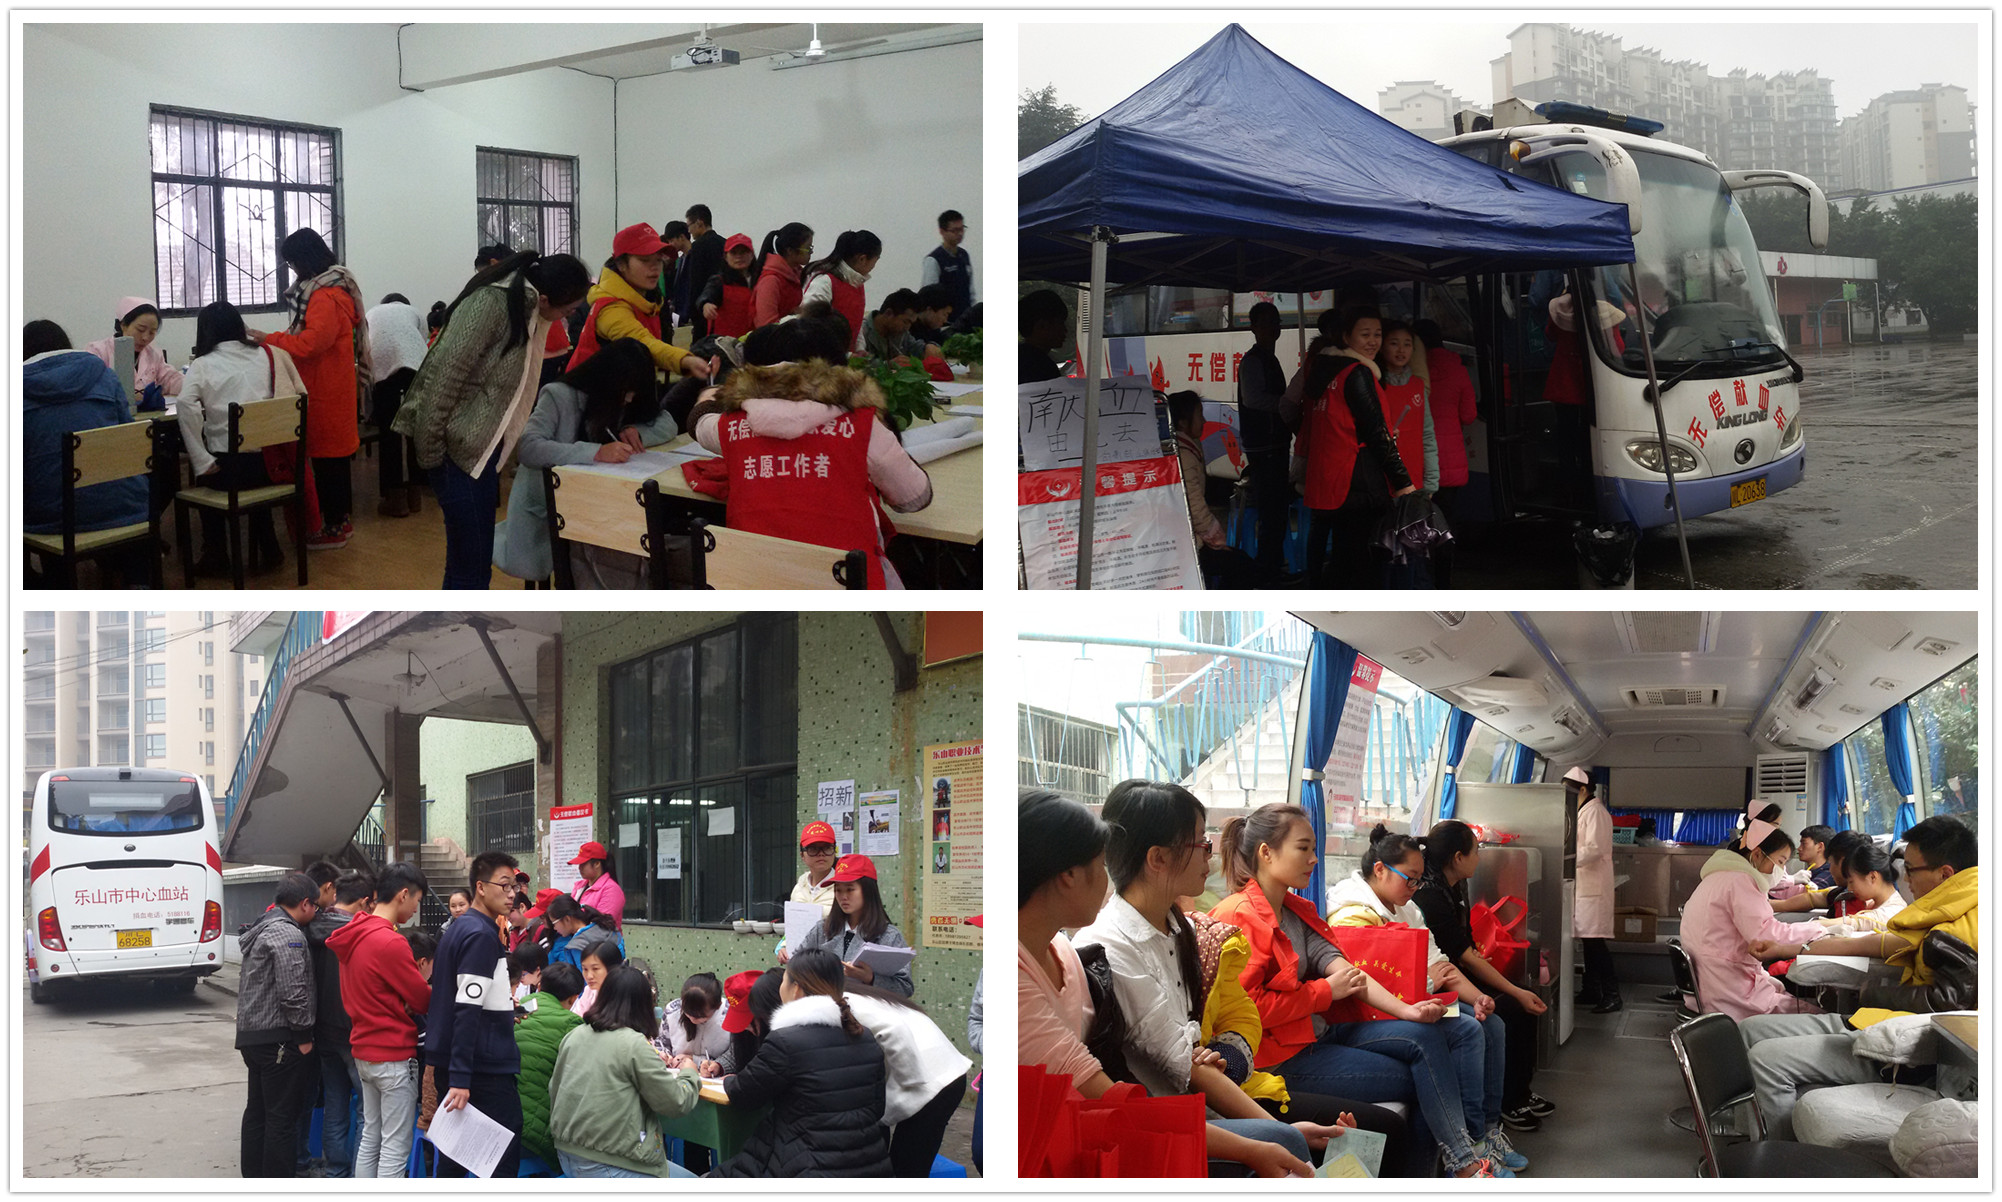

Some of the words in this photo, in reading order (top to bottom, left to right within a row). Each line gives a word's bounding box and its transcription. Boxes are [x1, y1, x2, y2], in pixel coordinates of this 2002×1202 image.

[1716, 413, 1742, 430] KING
[1743, 409, 1768, 425] LONG
[743, 453, 831, 480] 志愿工作者
[1079, 470, 1157, 490] 馨提示
[932, 744, 984, 760] 乐山职业技术
[818, 785, 853, 807] 招新
[74, 886, 189, 906] 乐山市中心血站
[119, 937, 151, 947] 68258
